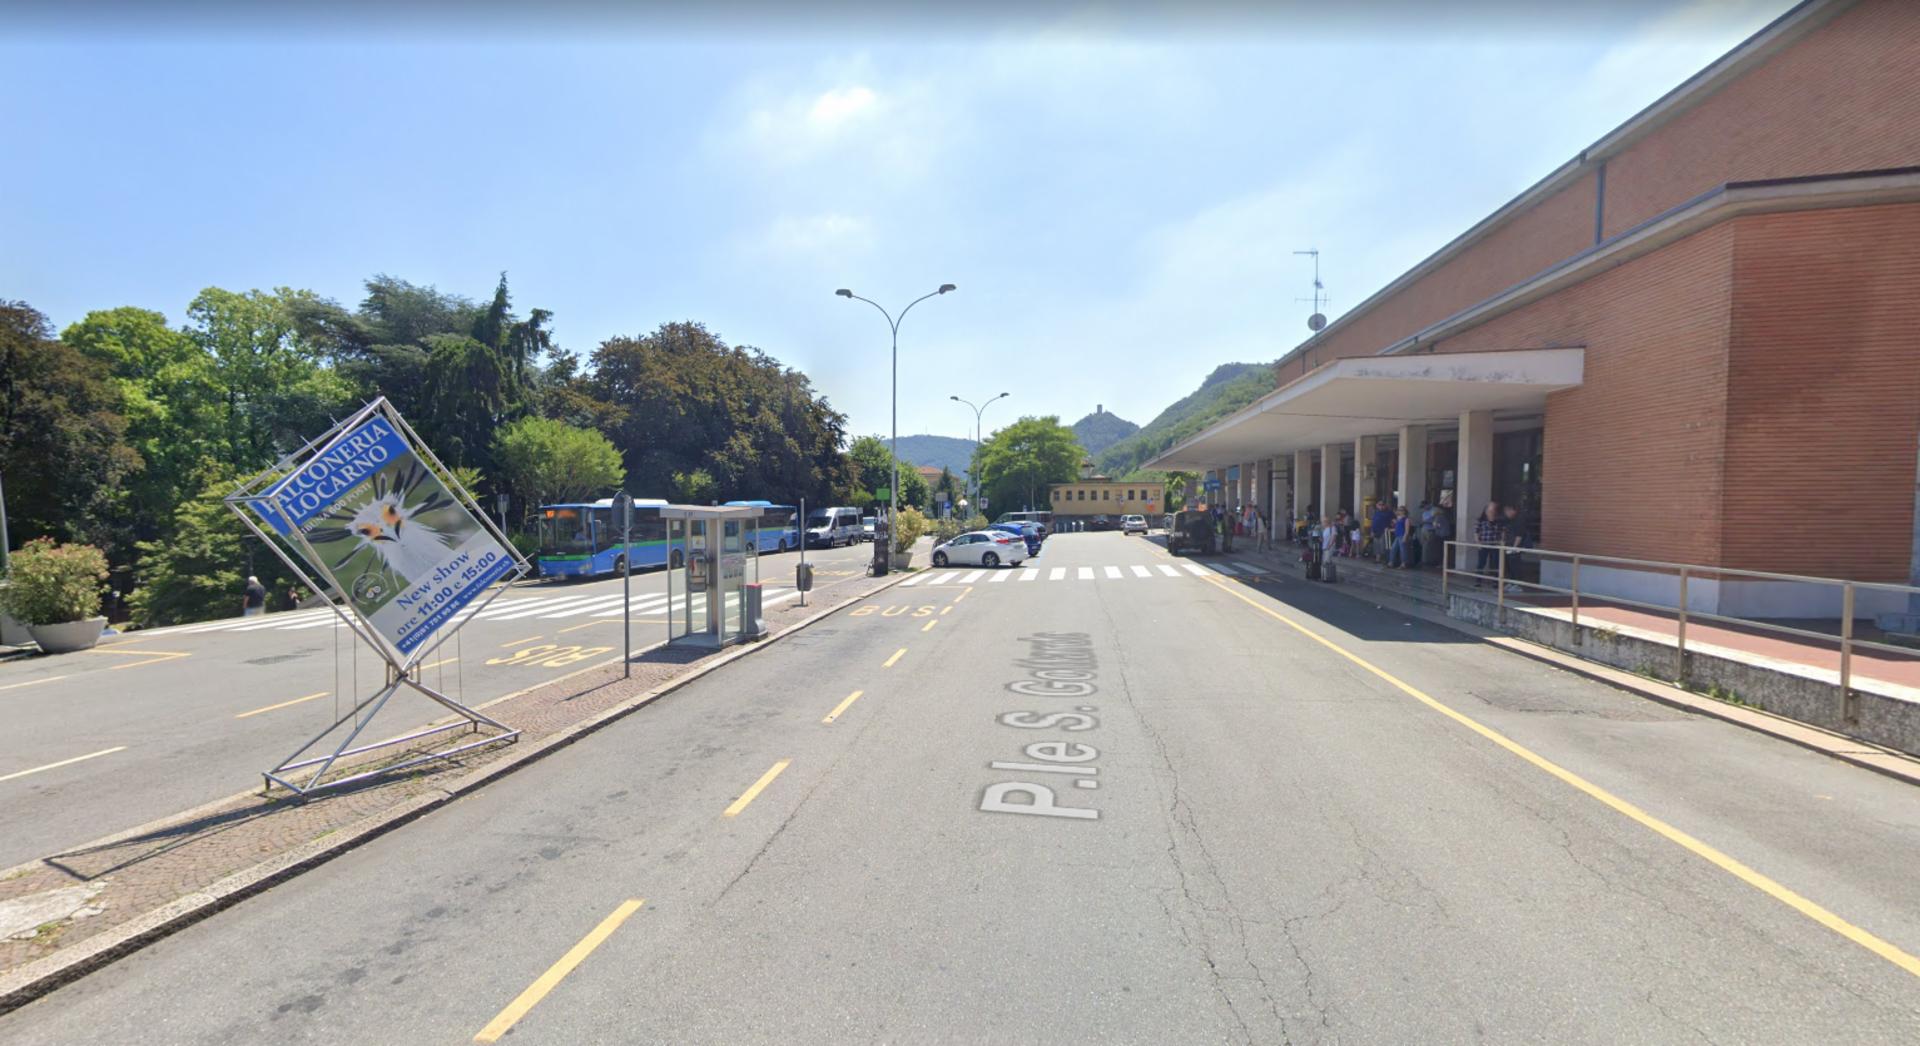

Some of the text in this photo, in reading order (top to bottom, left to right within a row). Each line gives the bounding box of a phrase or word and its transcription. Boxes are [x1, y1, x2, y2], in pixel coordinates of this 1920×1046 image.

[286, 445, 388, 519] LOCARNO
[396, 584, 431, 610] New
[433, 551, 469, 584] show
[397, 617, 418, 636] ore
[417, 586, 454, 616] 11:00
[453, 581, 463, 590] e
[461, 551, 497, 581] 15:00
[847, 605, 936, 617] BUS
